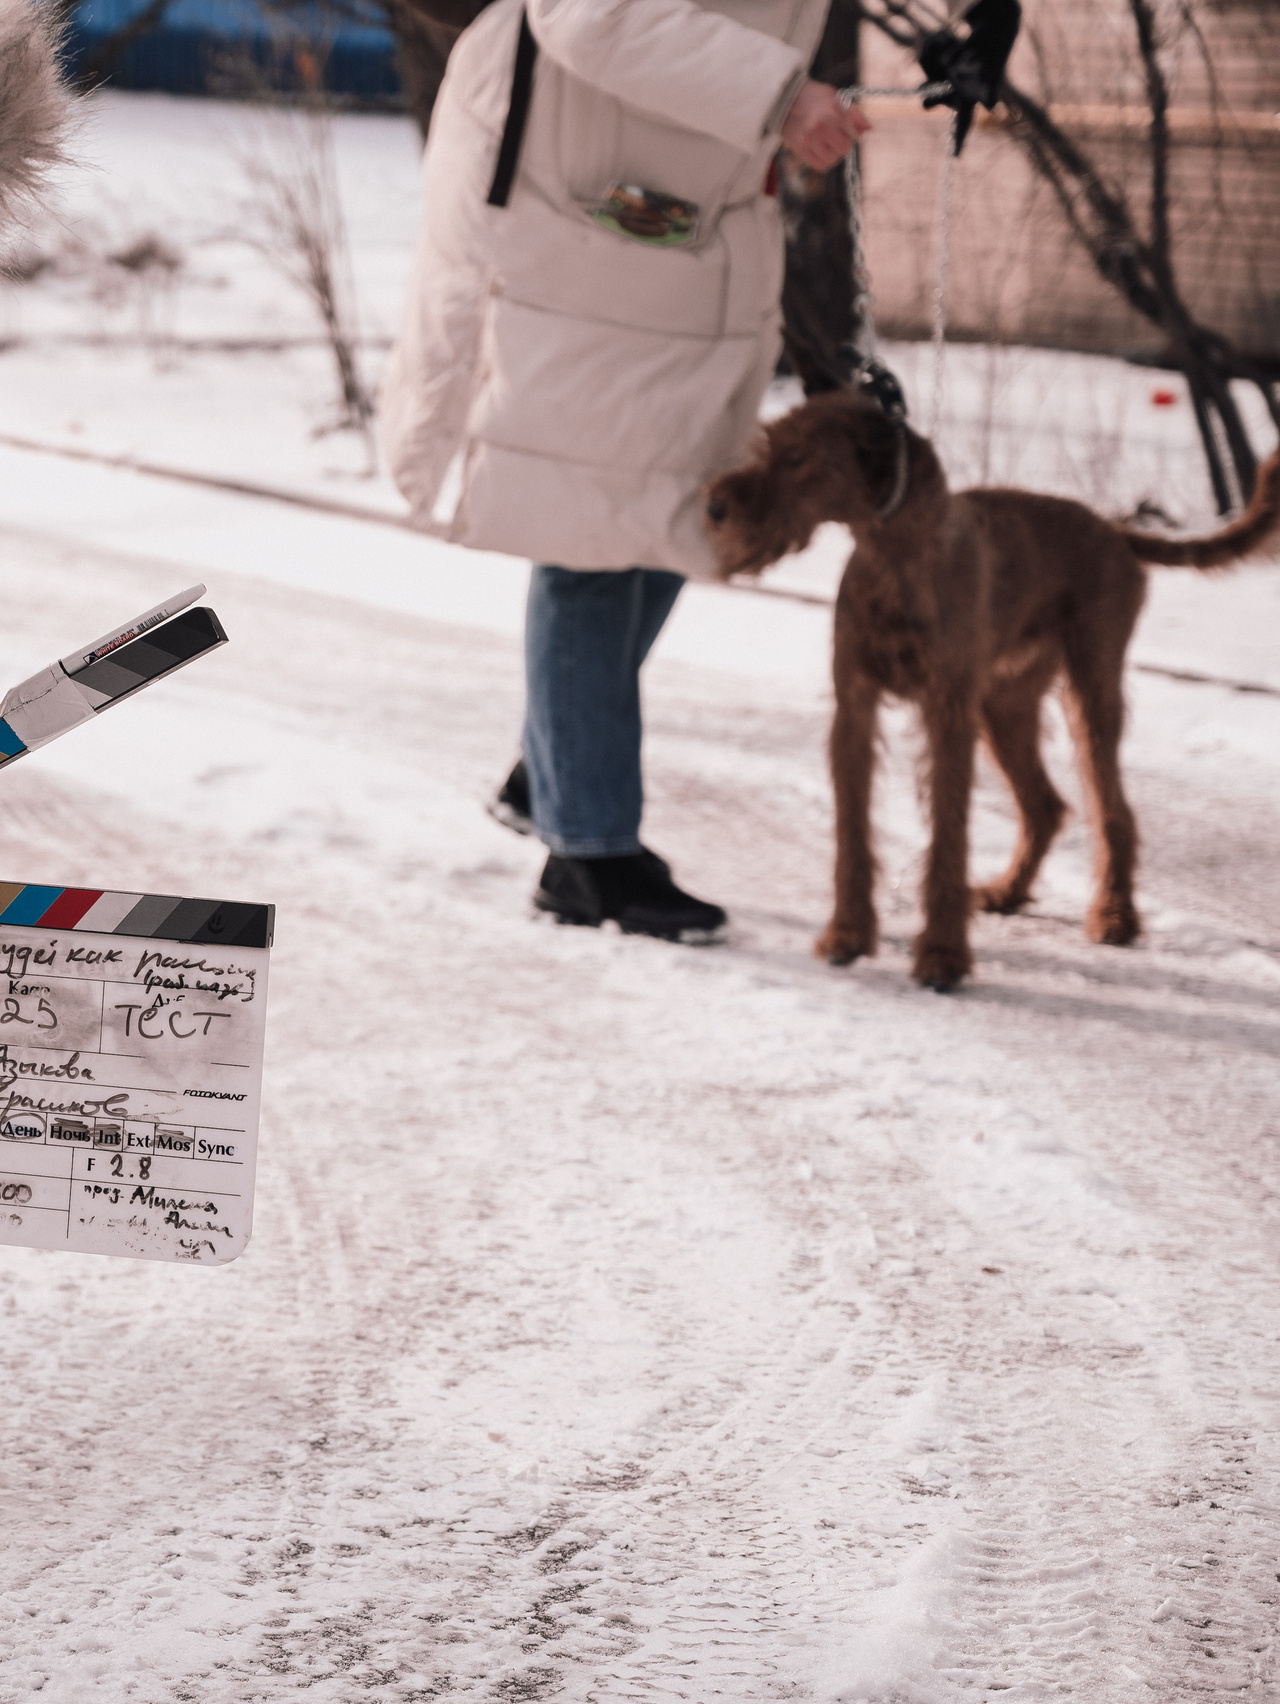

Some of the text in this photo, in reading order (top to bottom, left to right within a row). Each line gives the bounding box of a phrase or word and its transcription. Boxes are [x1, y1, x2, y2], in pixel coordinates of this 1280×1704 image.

[96, 632, 135, 657] WHITE BOARD
[65, 947, 123, 965] как
[182, 1088, 248, 1102] FOTOKVANT
[2, 1121, 91, 1142] День Ночь
[98, 1128, 236, 1159] Int Ext Mos Sync
[86, 1157, 96, 1172] F
